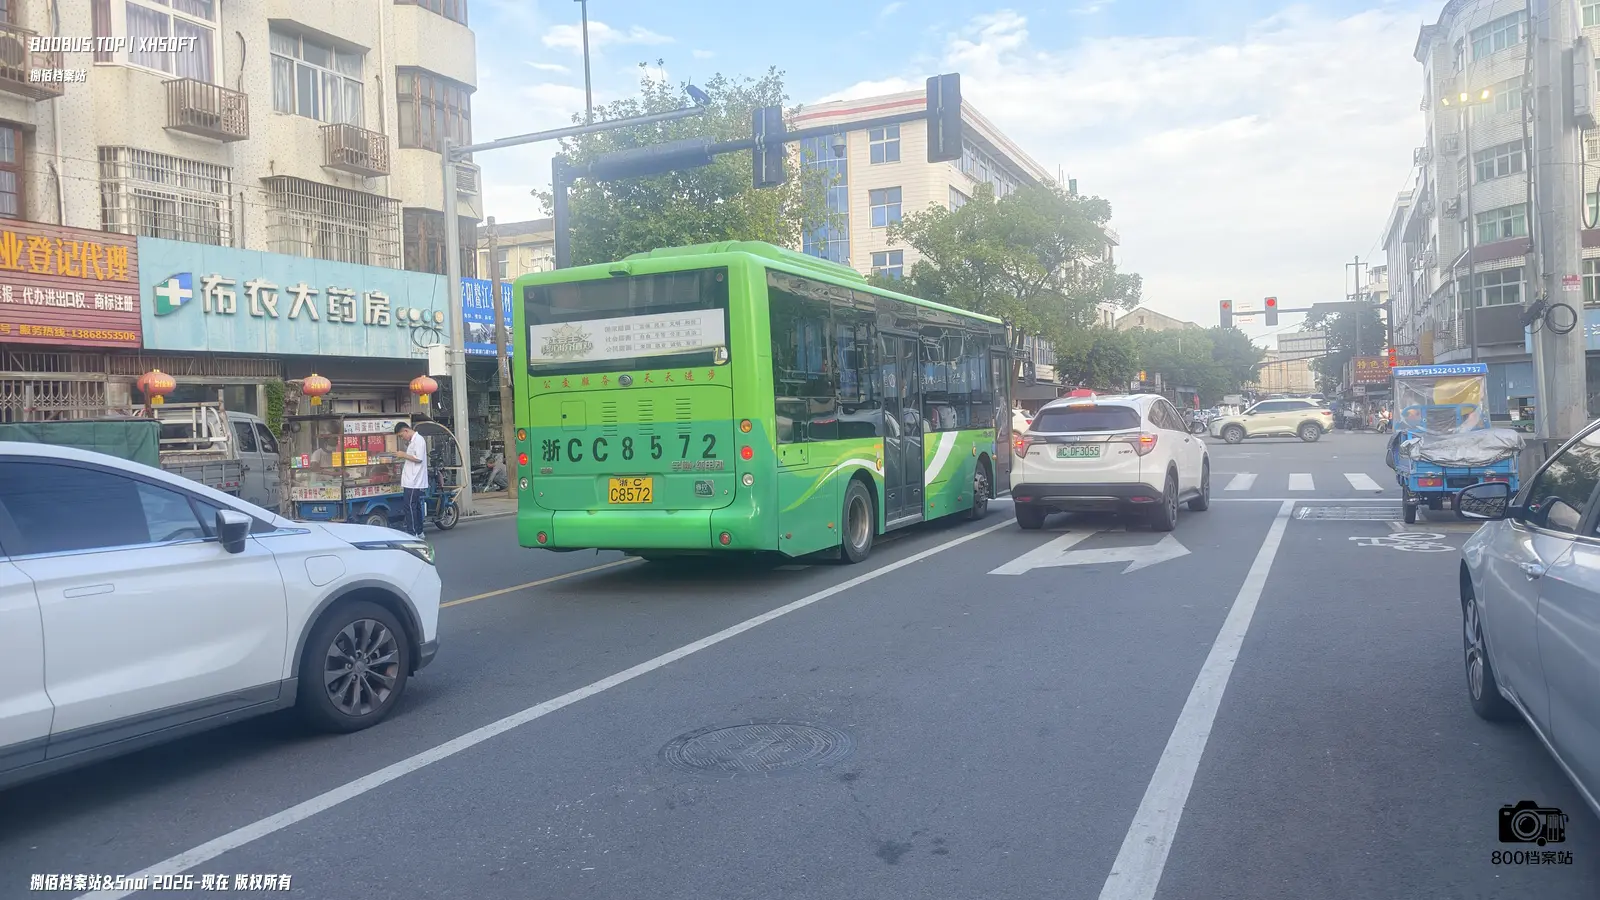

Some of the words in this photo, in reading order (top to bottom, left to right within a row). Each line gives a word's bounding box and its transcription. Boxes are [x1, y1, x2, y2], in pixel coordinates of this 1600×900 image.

[0, 284, 133, 312] 报、代办进出口权、商标注册
[200, 273, 392, 327] 布衣大药房
[543, 374, 611, 389] 公交服务
[643, 369, 716, 384] 天天进步
[541, 433, 717, 463] 浙CC8572
[610, 487, 651, 502] C8572
